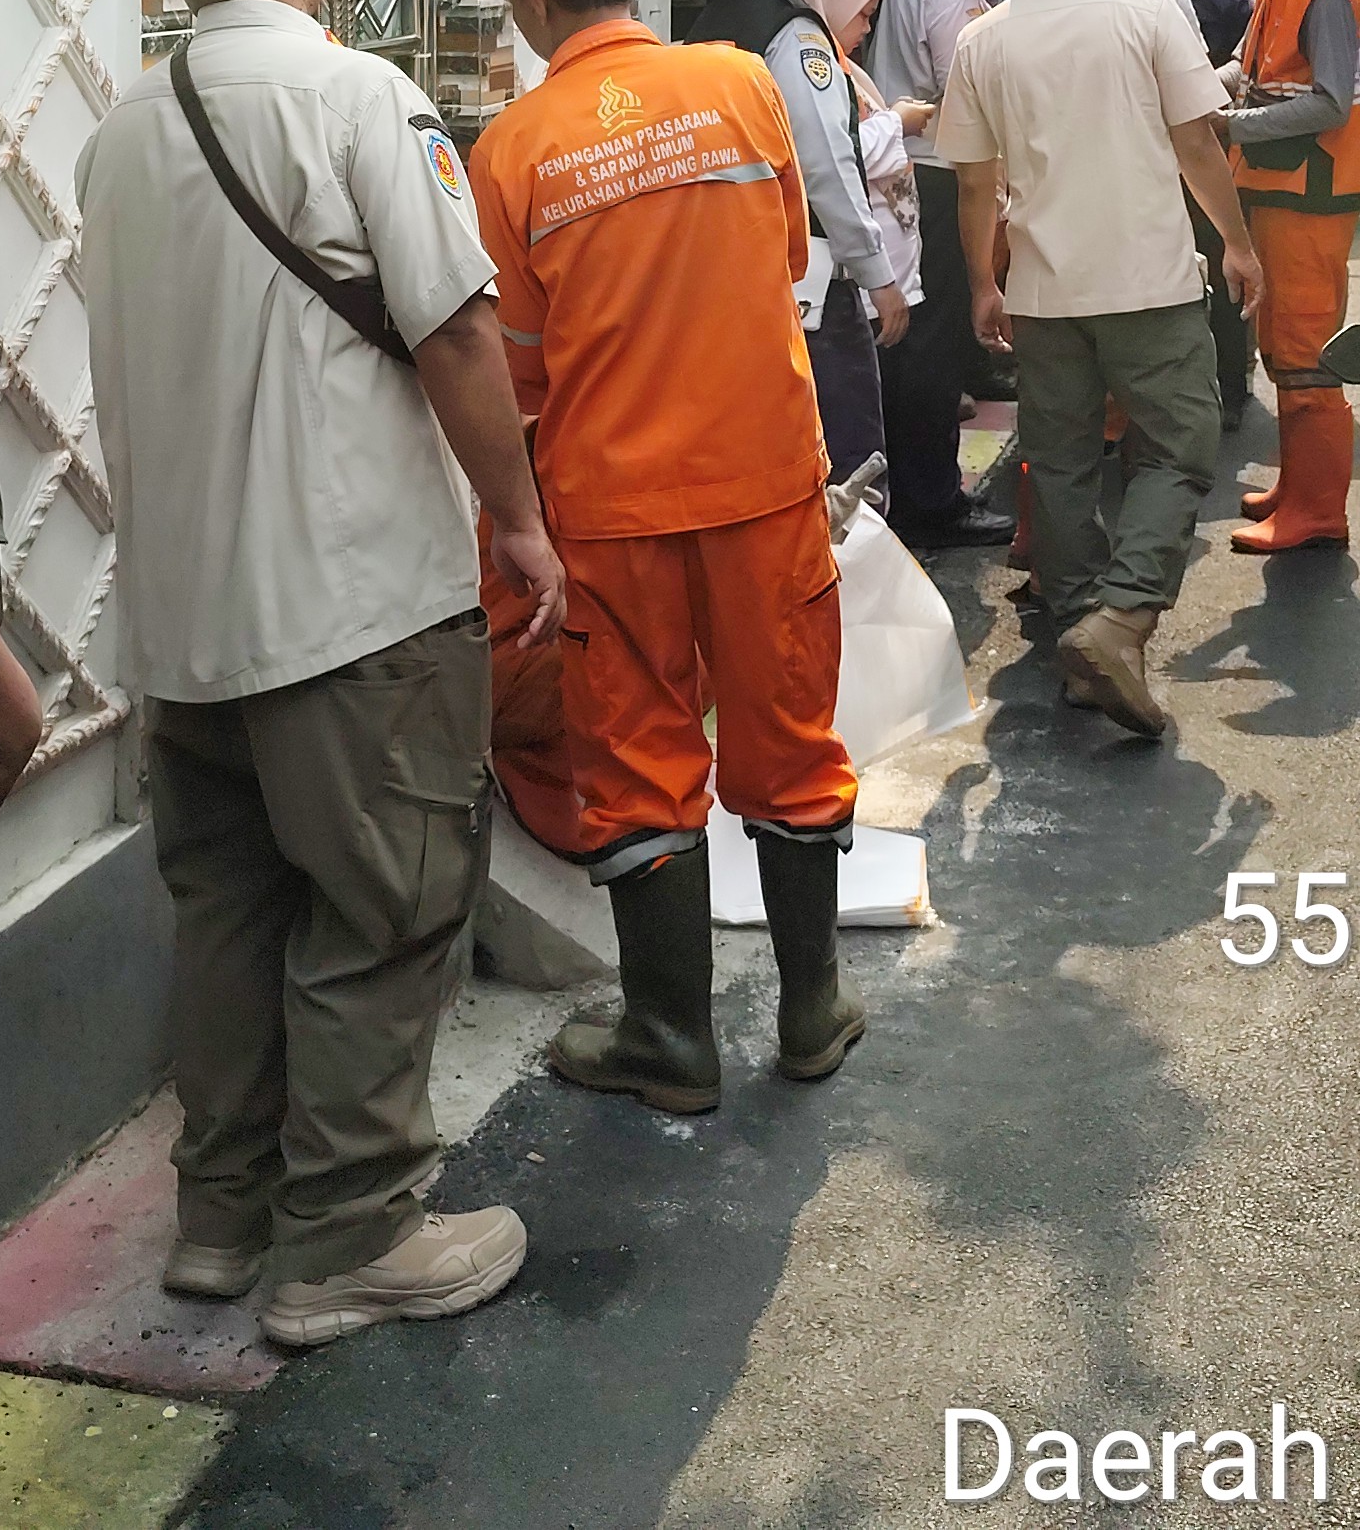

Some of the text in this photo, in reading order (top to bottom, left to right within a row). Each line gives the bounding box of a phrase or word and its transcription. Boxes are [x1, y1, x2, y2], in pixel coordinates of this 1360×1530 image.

[537, 109, 722, 180] PENANGANAN PRASARANA
[575, 134, 695, 187] & SARANA UMUM
[541, 148, 740, 222] KELURAHAN KAMPUNG RAWA
